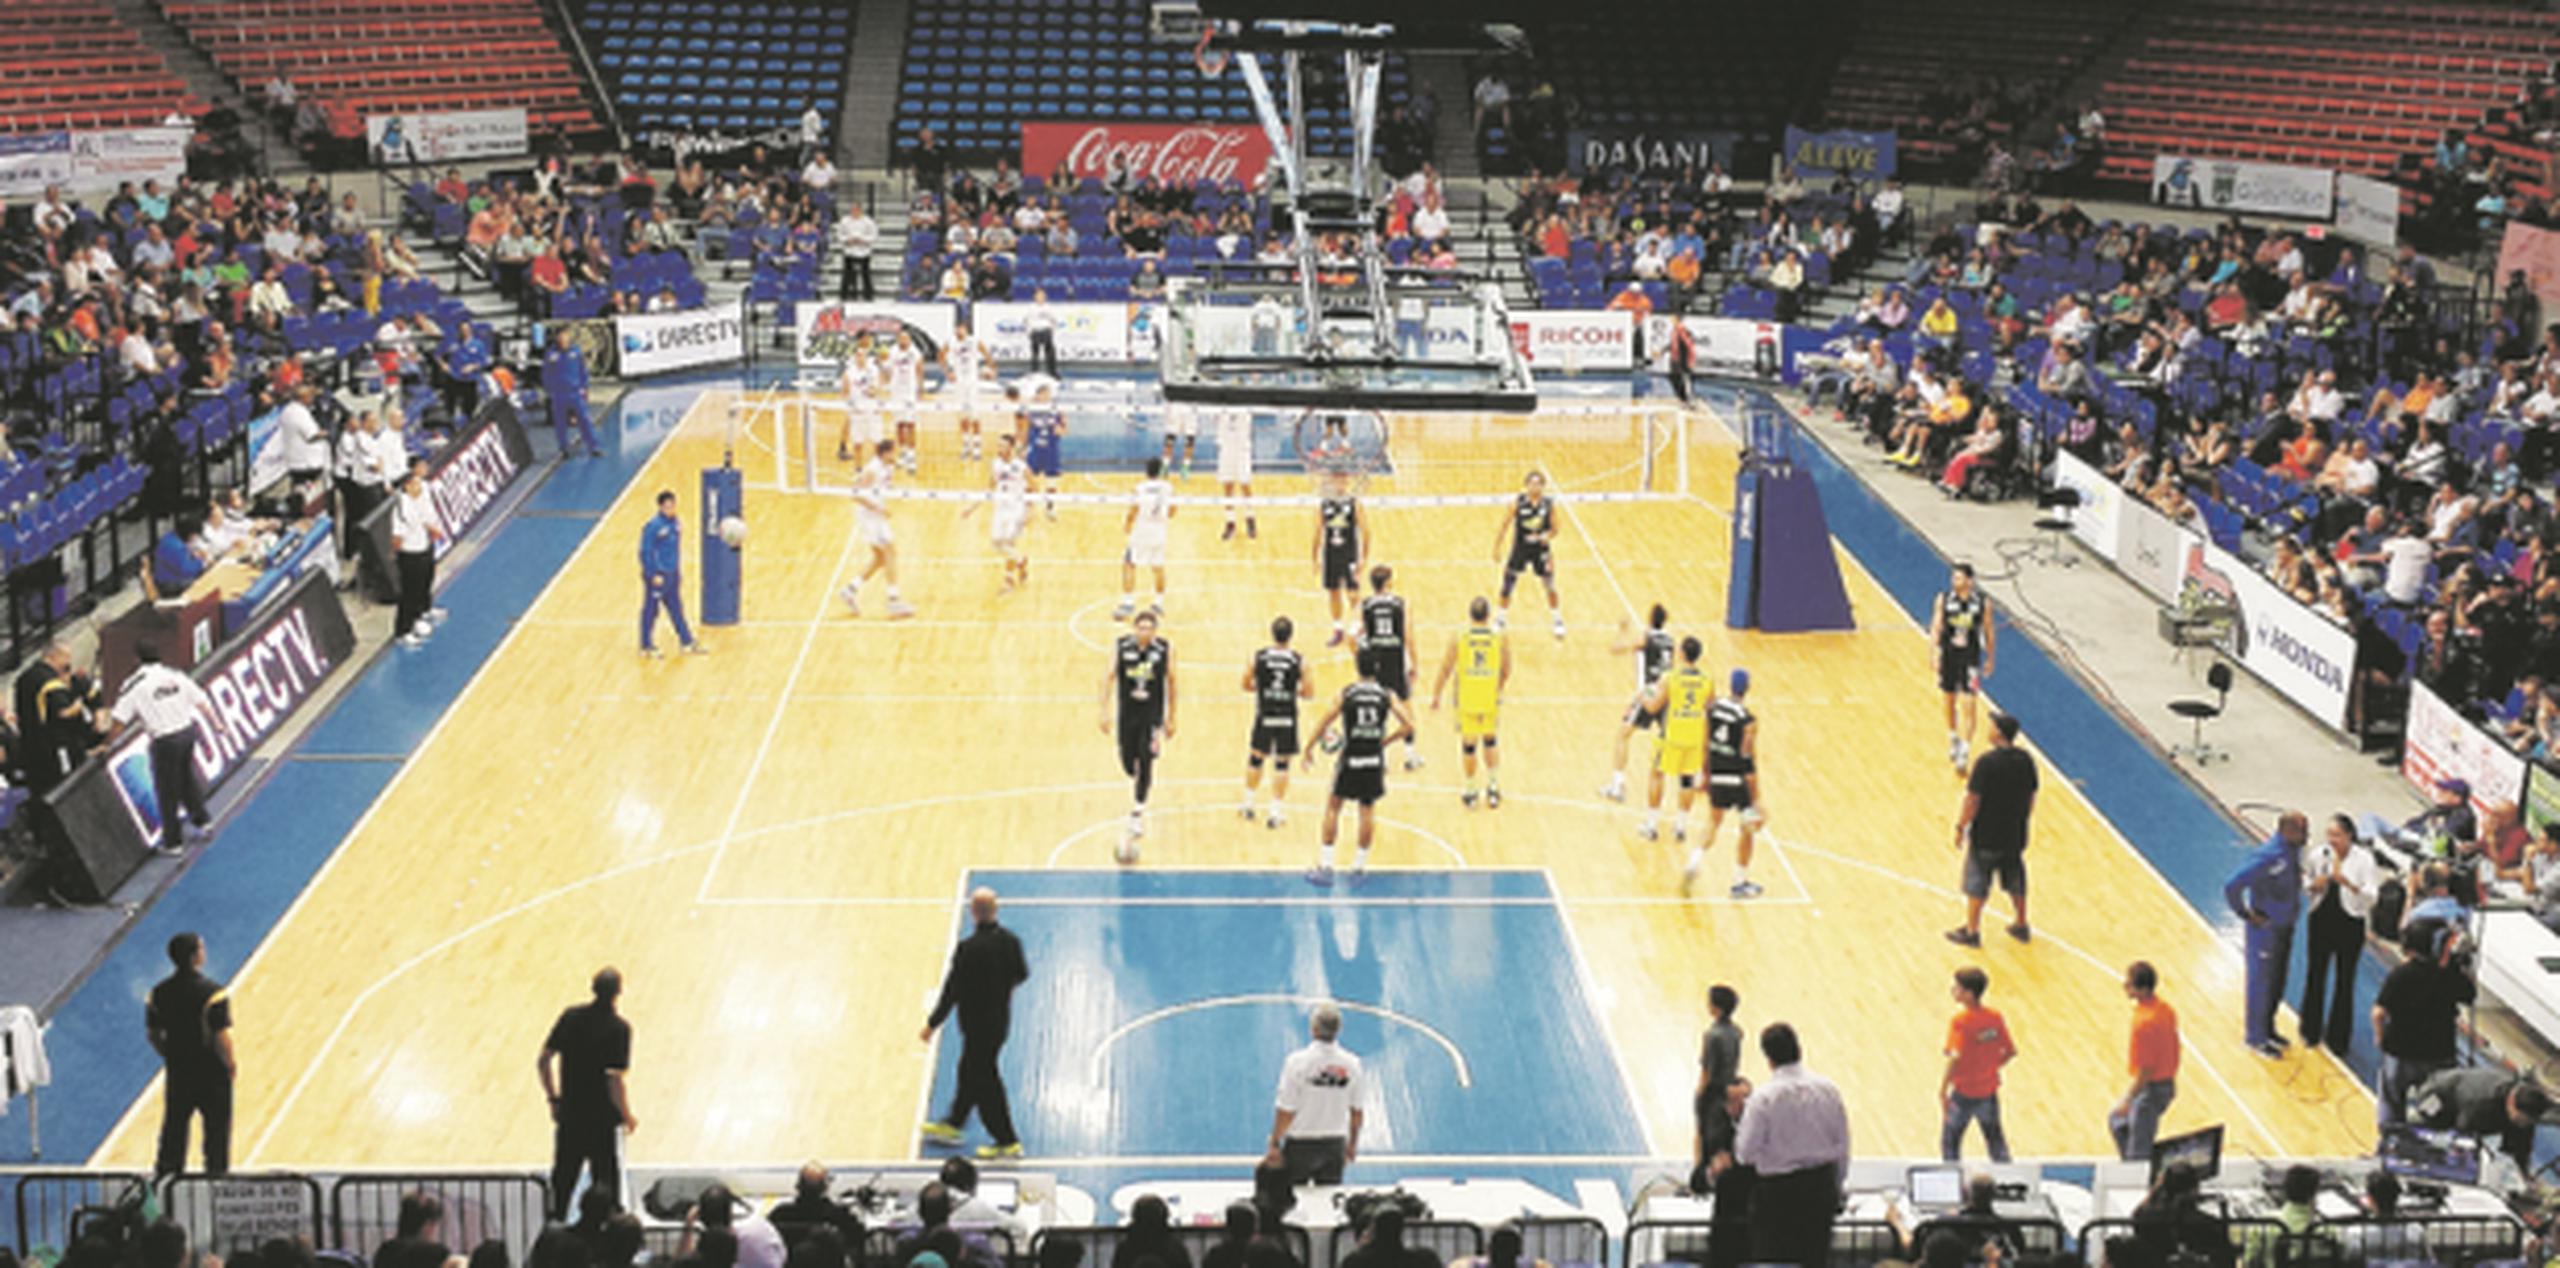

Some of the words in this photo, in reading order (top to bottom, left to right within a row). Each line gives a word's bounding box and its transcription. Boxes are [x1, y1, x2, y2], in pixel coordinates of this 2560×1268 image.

[1068, 127, 1247, 183] Coca-Cola
[1585, 134, 1708, 173] DASANI
[1793, 140, 1878, 170] ALEVE
[657, 318, 739, 349] DIRECTV
[1540, 327, 1623, 344] RICOH
[432, 421, 517, 535] DIRECTV
[2269, 625, 2344, 692] HONDA
[1714, 724, 1729, 743] 4
